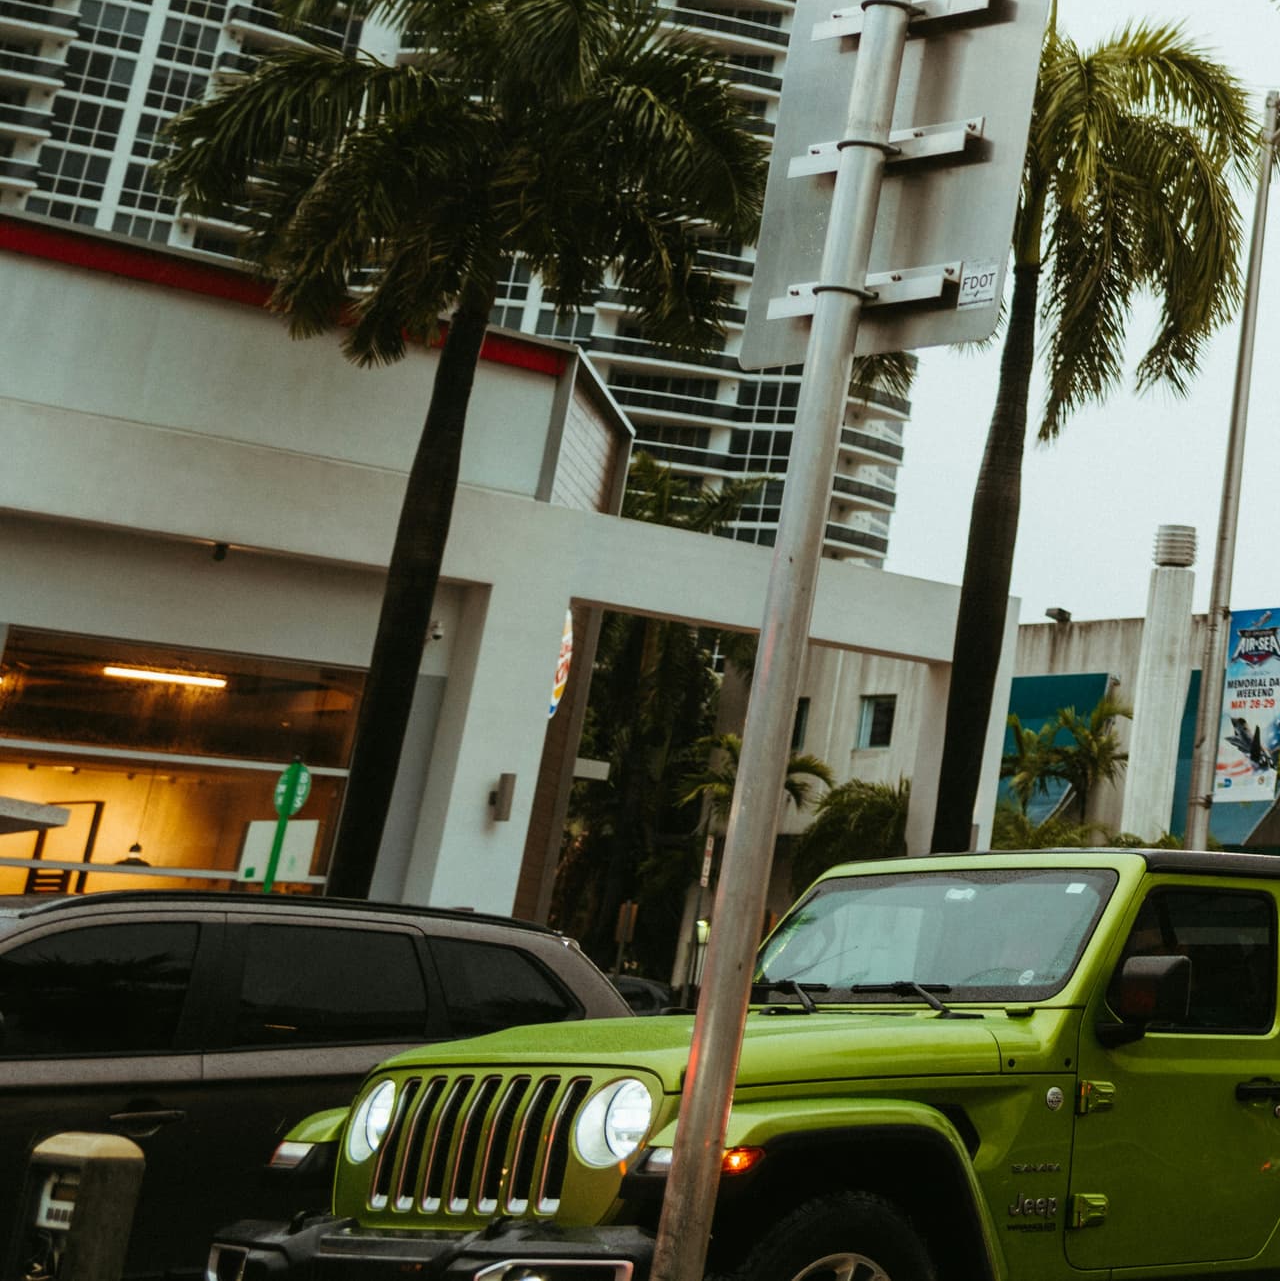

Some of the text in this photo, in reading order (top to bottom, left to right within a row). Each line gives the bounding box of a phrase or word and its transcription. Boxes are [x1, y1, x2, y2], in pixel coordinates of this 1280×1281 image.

[962, 272, 996, 291] FDOT
[1227, 679, 1267, 689] MEMORIAL
[1236, 688, 1274, 698] WEEKEND
[1230, 700, 1247, 710] MAY
[1008, 1192, 1057, 1217] Jeep
